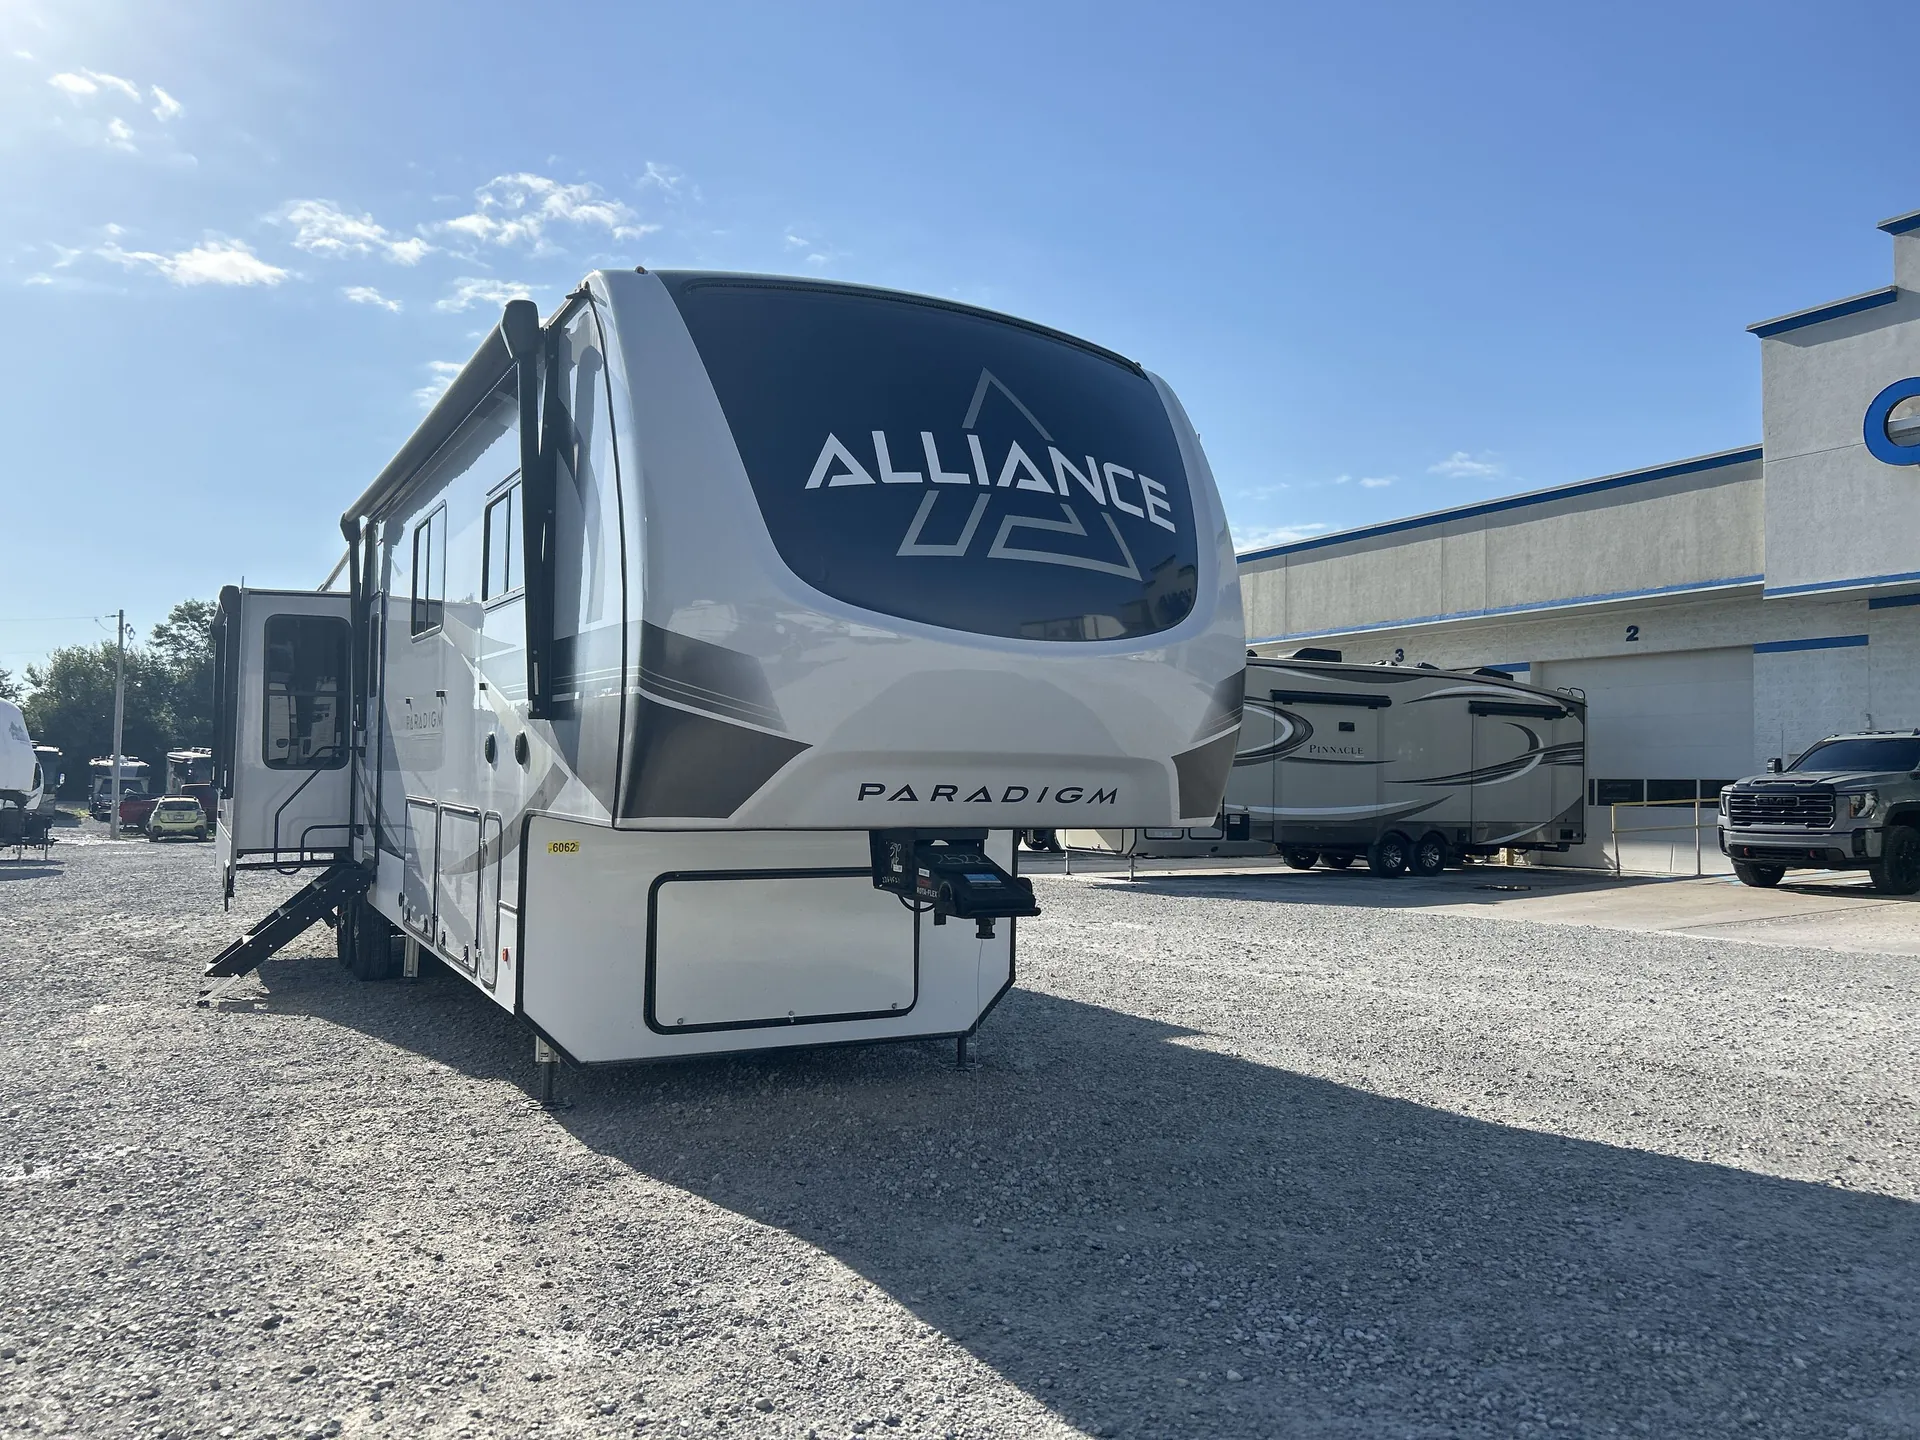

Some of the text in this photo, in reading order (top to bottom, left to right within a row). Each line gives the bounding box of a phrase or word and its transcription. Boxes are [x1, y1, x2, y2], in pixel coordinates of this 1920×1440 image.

[805, 430, 1176, 534] ALLIANCE
[1626, 625, 1639, 642] 2
[1395, 648, 1405, 662] 3
[406, 711, 443, 730] PARADIGM
[1309, 744, 1364, 755] PINNACLE
[857, 782, 1118, 805] PARADIGM
[1757, 797, 1796, 805] GMC
[552, 842, 576, 853] 6062
[916, 886, 939, 898] ROTA-FLEX
